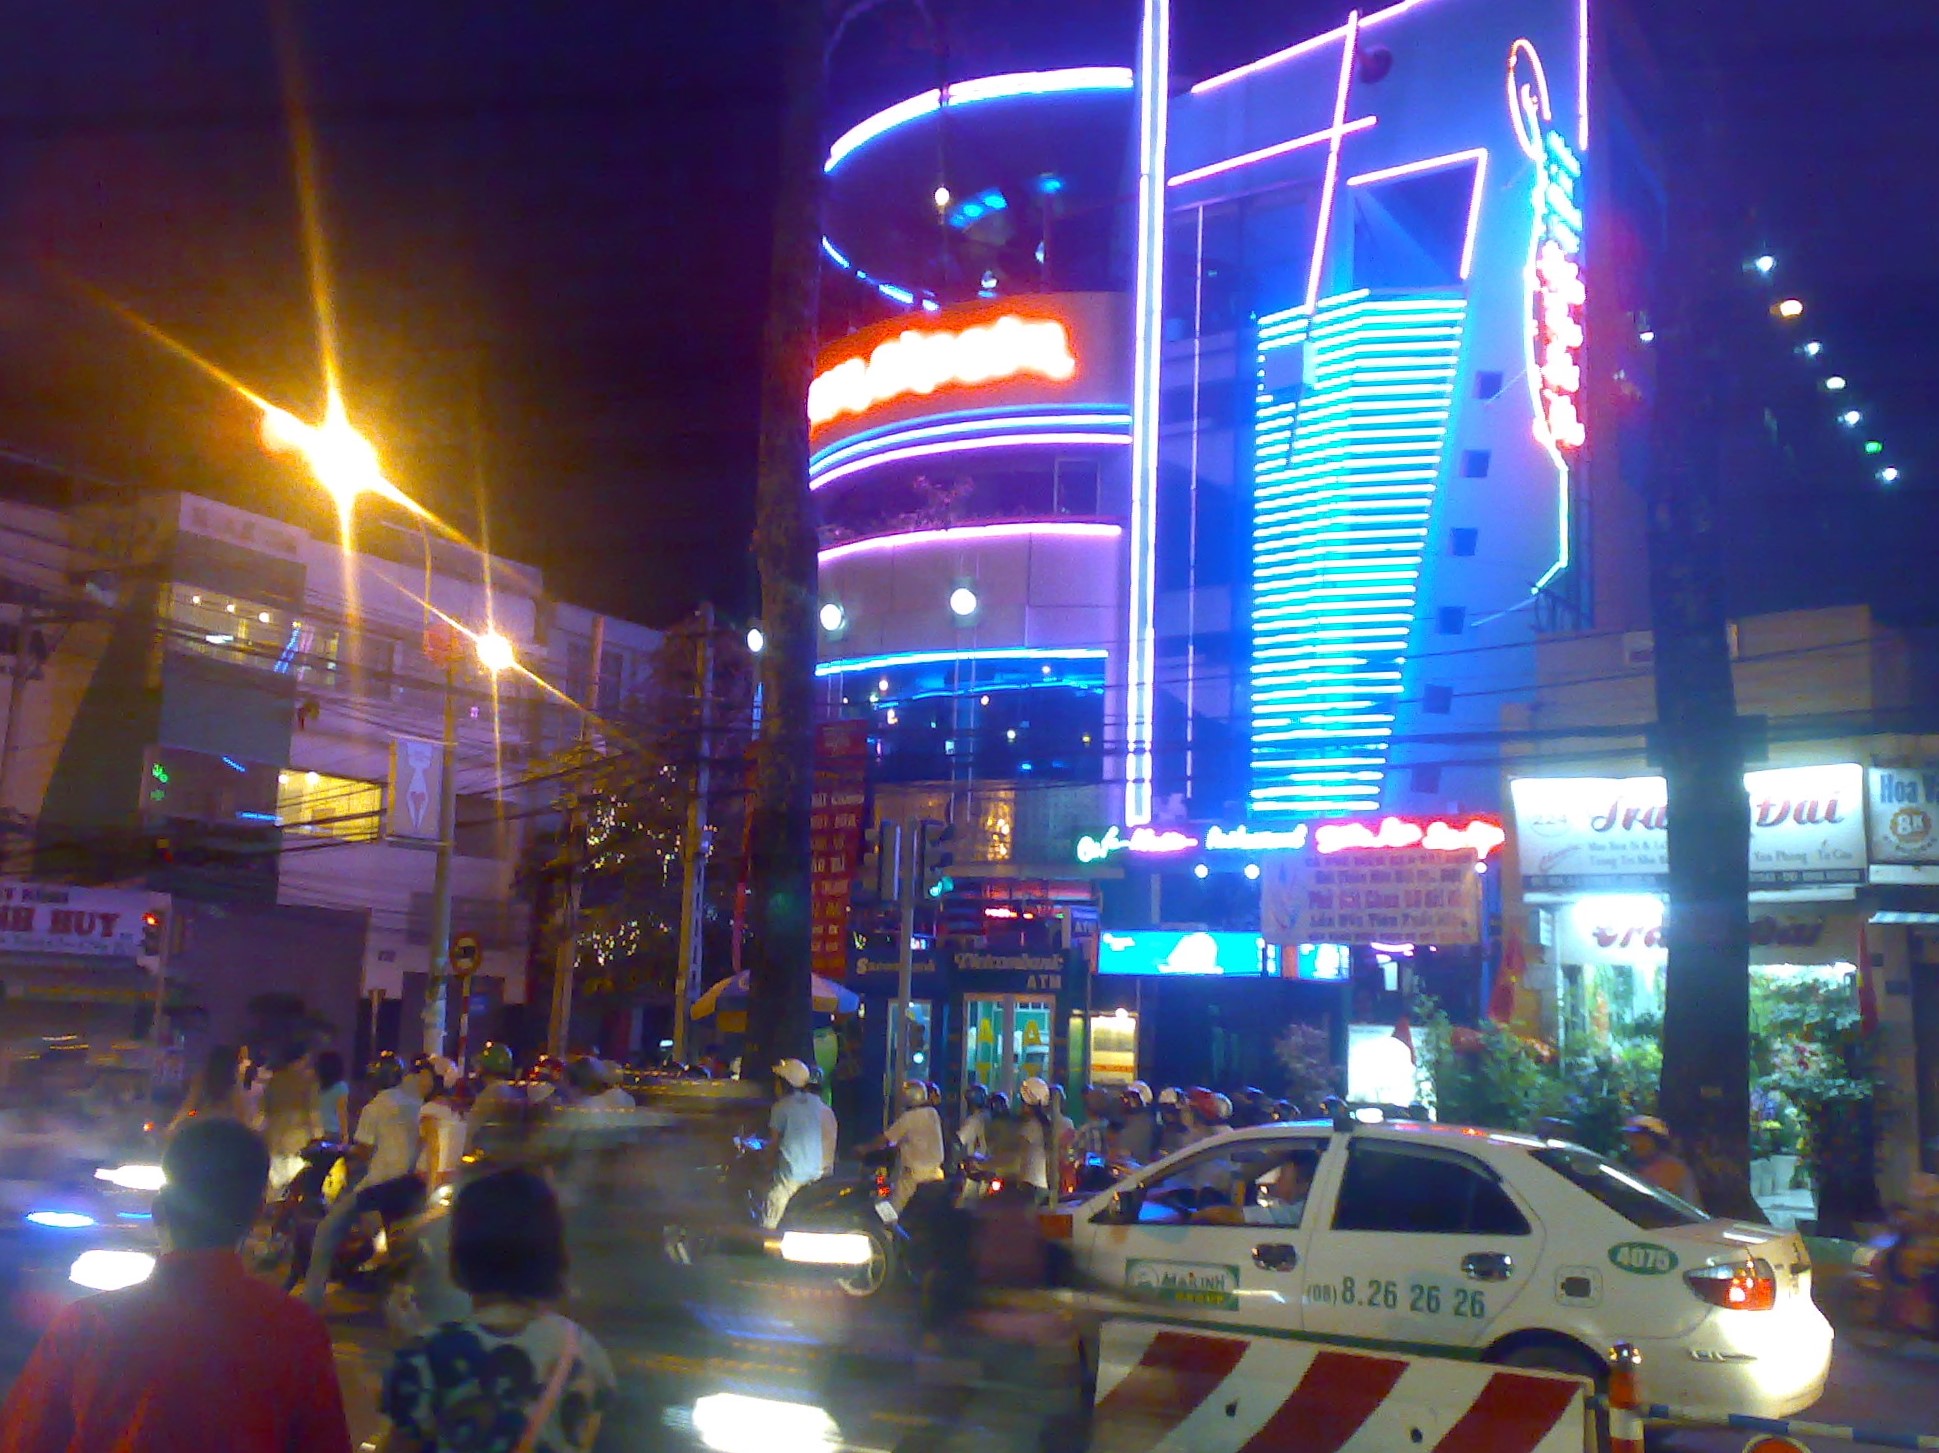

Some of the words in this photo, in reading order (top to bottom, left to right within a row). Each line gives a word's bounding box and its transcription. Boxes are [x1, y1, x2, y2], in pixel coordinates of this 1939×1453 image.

[1880, 774, 1918, 803] Hoa
[51, 910, 120, 937] HUY
[1027, 974, 1062, 989] ATM
[1341, 1275, 1399, 1310] 8.26
[1409, 1284, 1442, 1314] 26
[1453, 1286, 1486, 1319] 26
